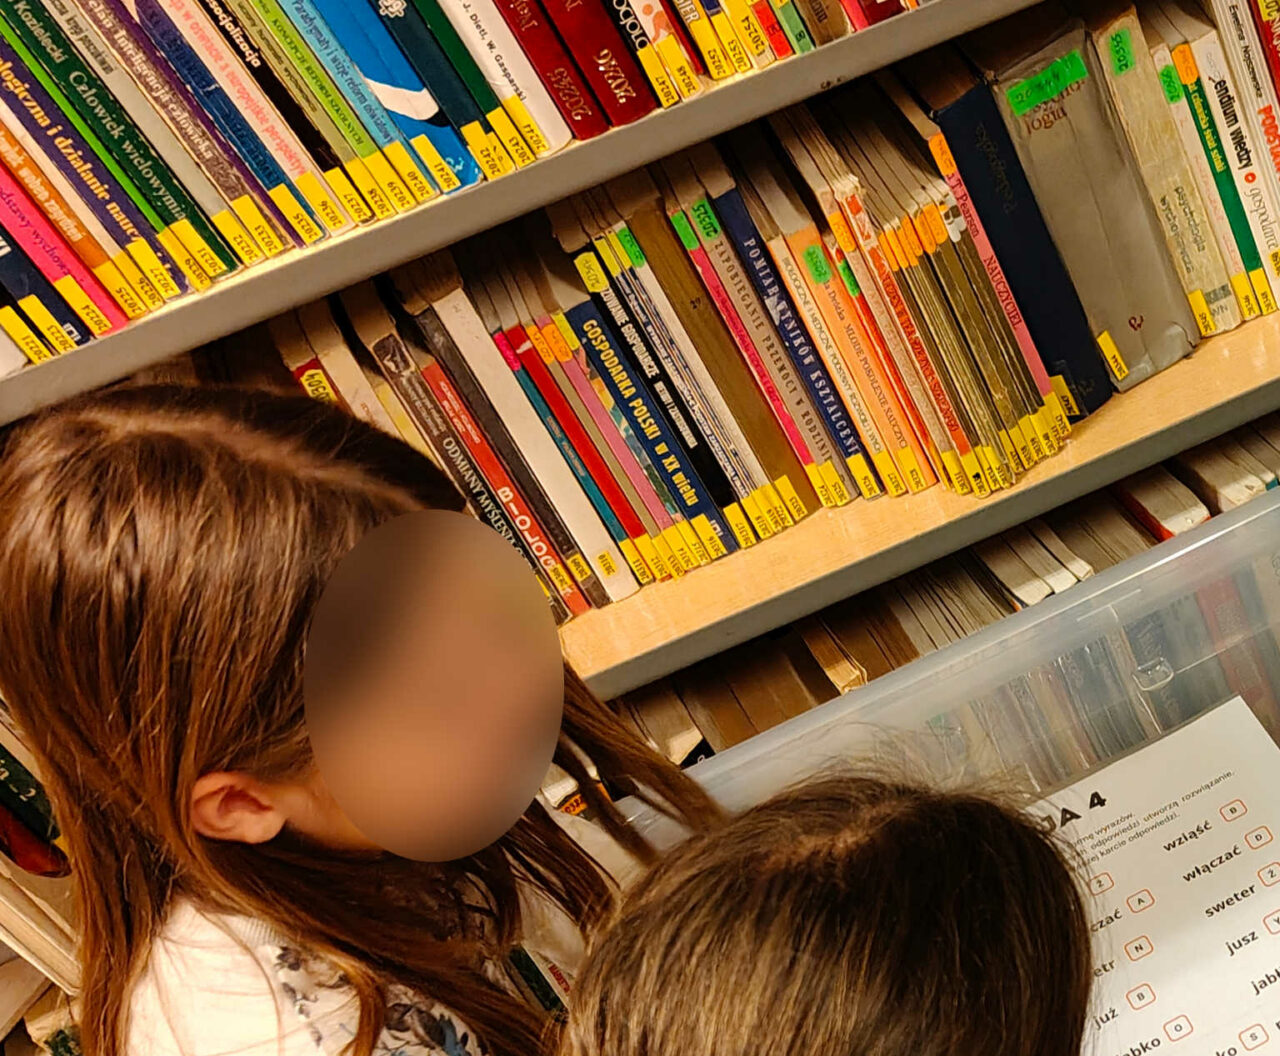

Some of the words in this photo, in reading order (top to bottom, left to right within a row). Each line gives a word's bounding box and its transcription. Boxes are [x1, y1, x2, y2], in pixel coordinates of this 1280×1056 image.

[1228, 4, 1246, 41] Ewelina
[13, 1, 68, 64] Kozielecki
[69, 71, 124, 139] Człowiek
[469, 13, 489, 42] Dietl,
[485, 39, 499, 57] W.
[494, 53, 528, 103] Gasparski
[707, 47, 727, 76] 20252
[728, 39, 748, 70] 20253
[113, 30, 170, 103] Inteligencja
[168, 101, 213, 159] człowieka
[654, 75, 676, 103] 20247
[676, 65, 697, 94] 20248
[509, 135, 532, 165] 20243
[522, 123, 546, 151] 20244
[1228, 127, 1254, 171] wiedzy
[54, 136, 111, 200] działanie
[434, 161, 457, 189] 20241
[478, 145, 501, 176] 20242
[386, 179, 410, 213] 20239
[407, 169, 431, 198] 20240
[292, 211, 320, 241] 20235
[319, 199, 342, 230] 20236
[694, 203, 719, 238] 20325
[232, 234, 260, 262] 20232
[252, 223, 279, 253] 20233
[196, 248, 223, 275] 20231
[744, 239, 779, 297] POMIAR
[958, 194, 980, 238] Pearson
[984, 256, 1022, 328] NAUCZYCIEL
[138, 276, 163, 308] 20226
[150, 268, 175, 297] 20227
[115, 287, 143, 315] 20225
[82, 305, 111, 331] 20224
[713, 241, 765, 331] ZAPOBIEGANIE
[763, 335, 798, 395] PRZEMOCY
[46, 324, 72, 352] 20223
[621, 325, 659, 379] GOSPODARCZE
[582, 319, 638, 399] GOSPODARKA
[629, 397, 661, 440] POLSKI
[662, 453, 678, 473] XX
[671, 469, 699, 507] wieku
[442, 436, 484, 496] ODMIANY
[859, 474, 874, 496] 20326
[705, 534, 724, 557] 20316
[597, 551, 615, 575] 20310
[630, 556, 650, 581] 20311
[1089, 791, 1107, 809] 4
[1091, 820, 1141, 851] odpowiedzi
[1143, 800, 1180, 823] utworzą
[1181, 770, 1235, 802] rozwiązanie.
[1095, 812, 1135, 836] wyrazów.
[1099, 840, 1127, 857] karcie
[1128, 811, 1181, 842] odpowiedzi.
[1162, 820, 1213, 852] wziąść
[1182, 844, 1242, 883] włączać
[1204, 884, 1257, 918] sweter
[1093, 1007, 1119, 1031] już
[1225, 930, 1260, 957] jusz
